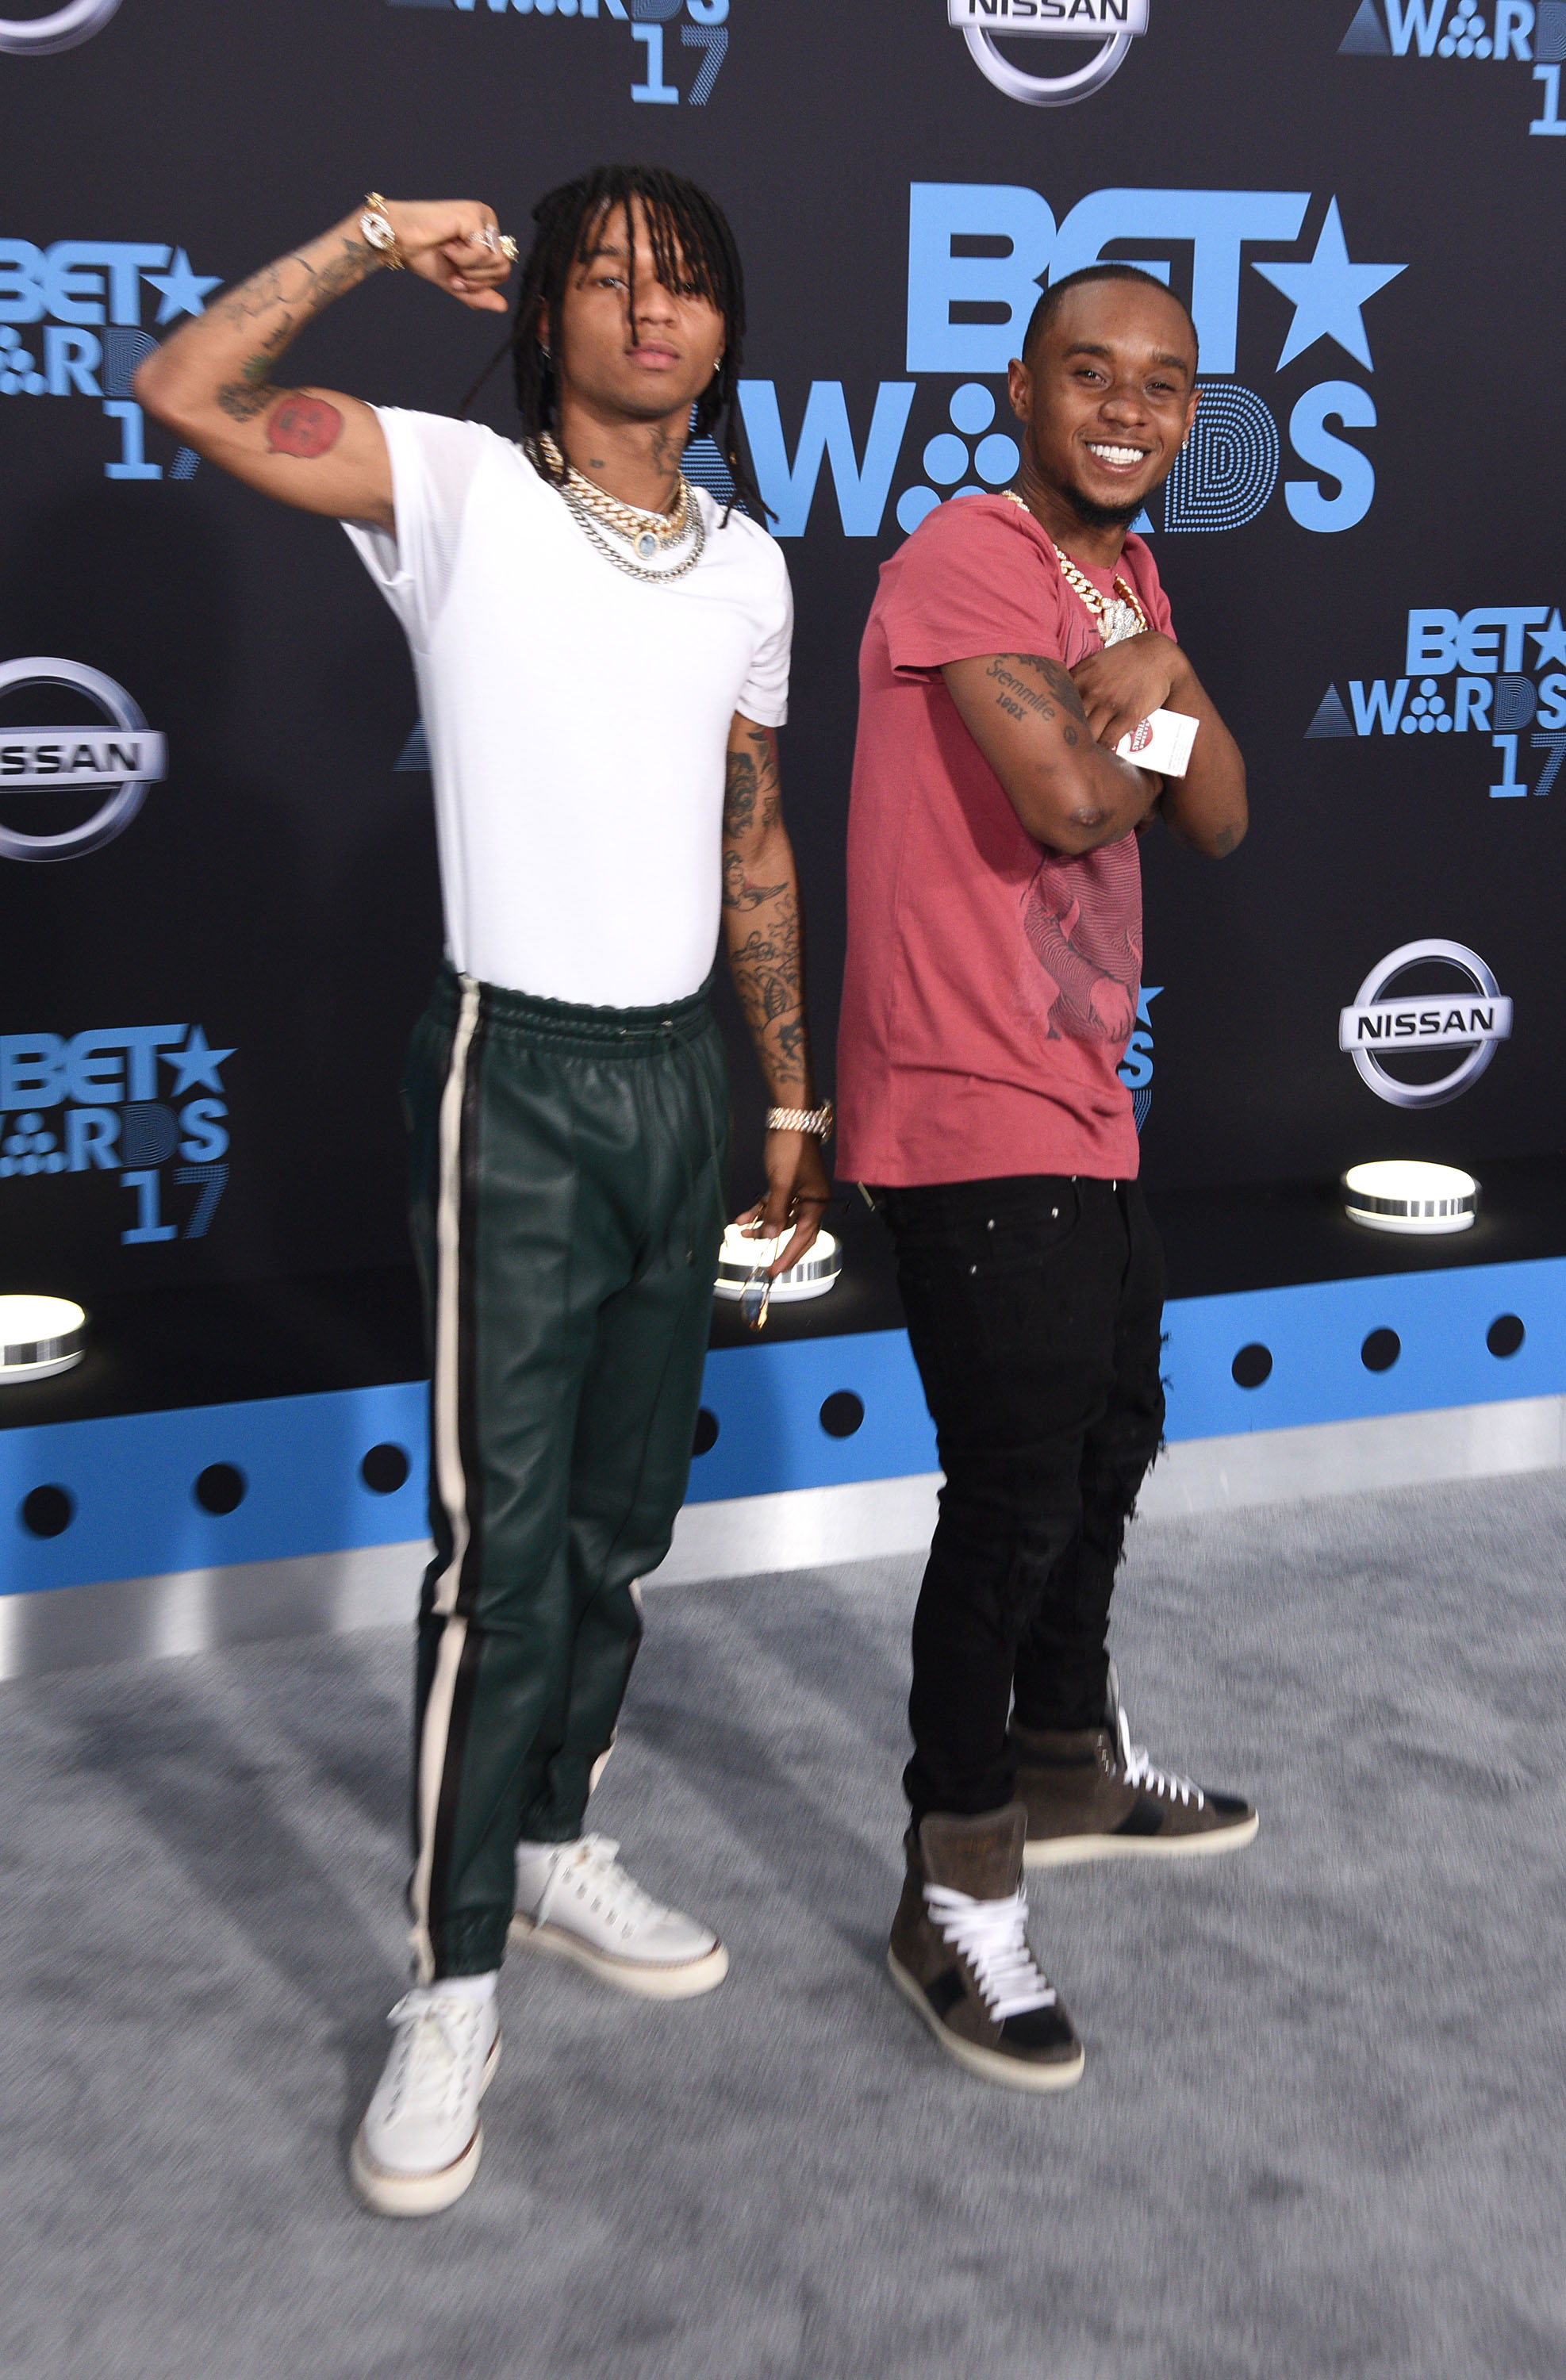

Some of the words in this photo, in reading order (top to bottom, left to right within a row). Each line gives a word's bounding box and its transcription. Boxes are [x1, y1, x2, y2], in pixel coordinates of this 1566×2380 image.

[630, 21, 729, 106] 17
[102, 399, 202, 480] 1
[1406, 606, 1550, 675] BET
[1303, 674, 1566, 739] AWARDS
[1489, 732, 1566, 798] 17
[1357, 1007, 1493, 1040] NISSAN
[0, 1023, 190, 1111] BET
[0, 1098, 230, 1179] ARDS
[121, 1163, 229, 1245] 17
